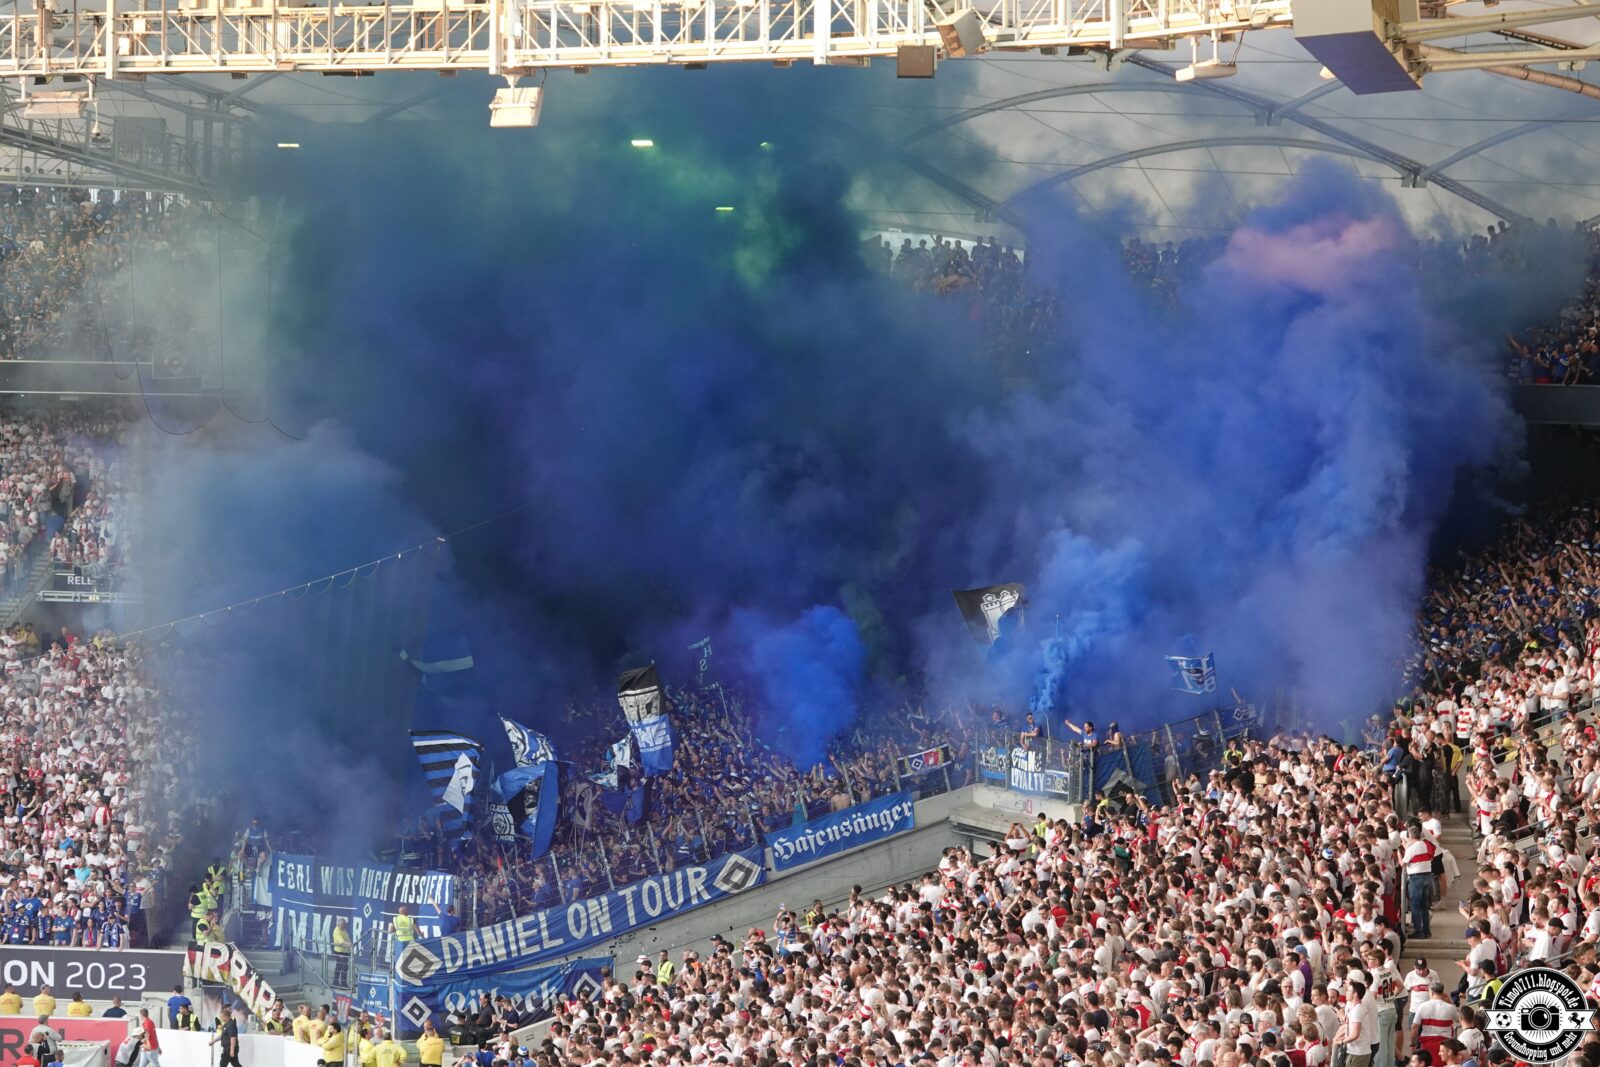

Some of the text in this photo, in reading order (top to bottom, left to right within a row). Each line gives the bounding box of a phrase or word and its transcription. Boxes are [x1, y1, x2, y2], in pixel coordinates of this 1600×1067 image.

[1011, 767, 1045, 792] LOYALTY
[773, 800, 913, 863] Hafensänger
[277, 859, 452, 905] EGAL WAS AUCH PASSIERT
[274, 907, 363, 956] IMMR
[440, 908, 564, 973] DANIEL
[566, 896, 613, 940] ON
[618, 866, 712, 926] TOUR
[0, 959, 147, 991] ON 2023
